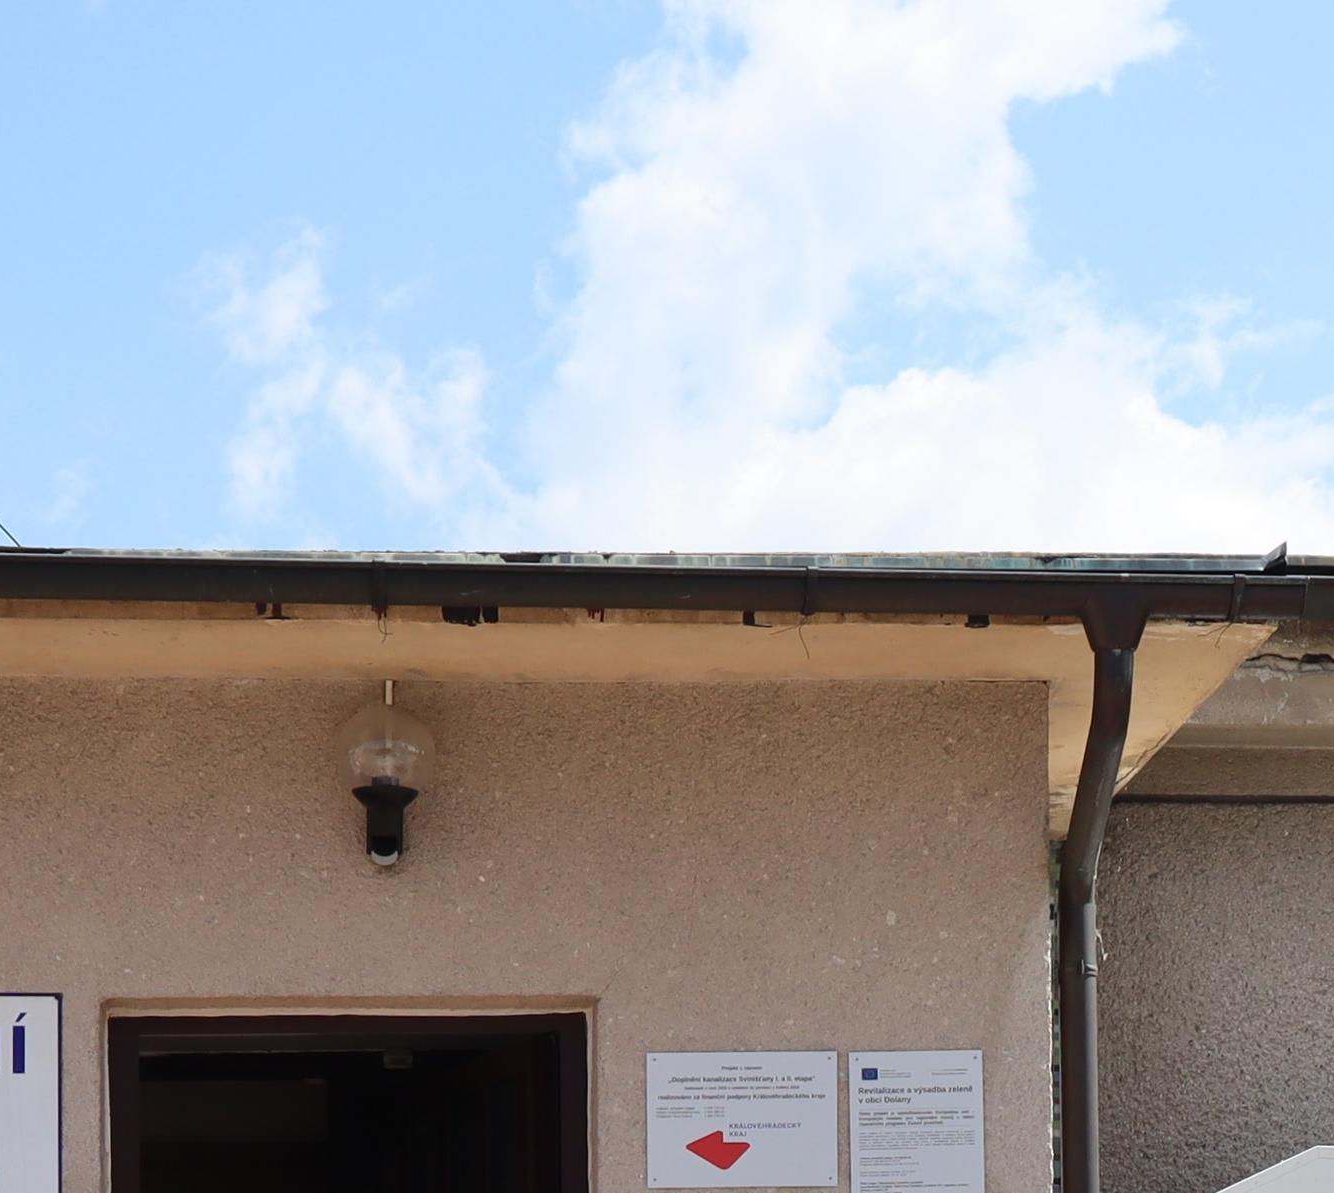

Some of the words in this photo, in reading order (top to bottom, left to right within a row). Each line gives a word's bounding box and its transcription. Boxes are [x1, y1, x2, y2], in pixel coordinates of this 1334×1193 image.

[858, 1087, 905, 1095] Revitalizace
[913, 1086, 946, 1095] výsadba
[948, 1085, 973, 1093] zeleně
[884, 1096, 912, 1104] Dolany
